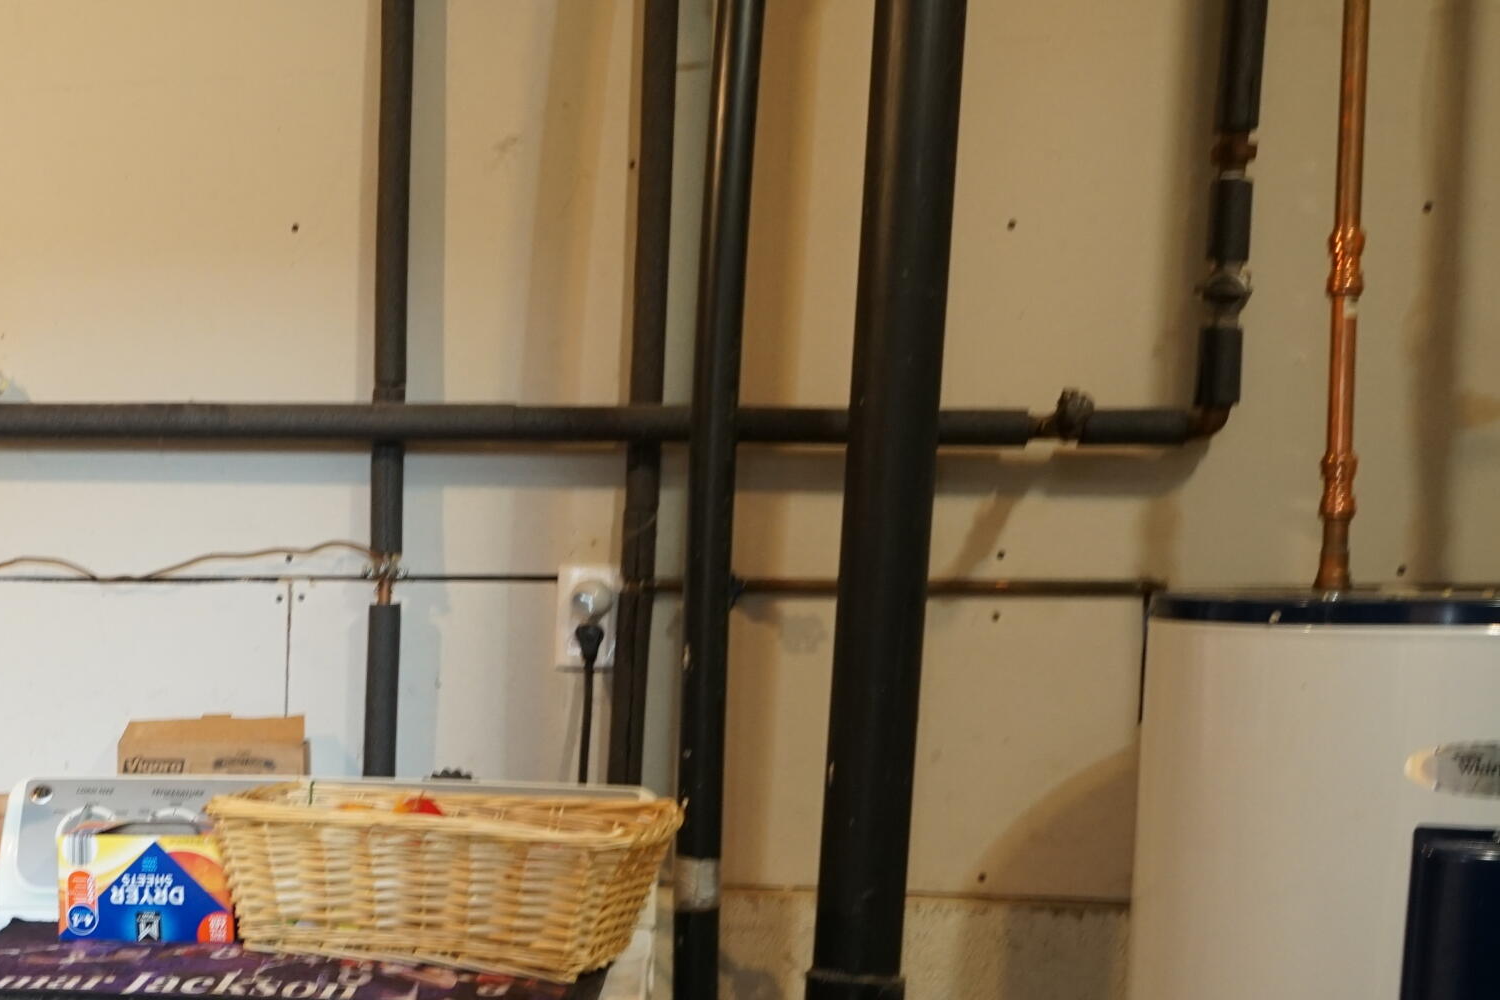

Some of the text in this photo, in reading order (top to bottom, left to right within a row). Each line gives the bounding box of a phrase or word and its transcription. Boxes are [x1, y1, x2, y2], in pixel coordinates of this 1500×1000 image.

[121, 873, 173, 887] SHEETS
[109, 885, 185, 906] DRYER
[120, 968, 360, 1000] Jackson
